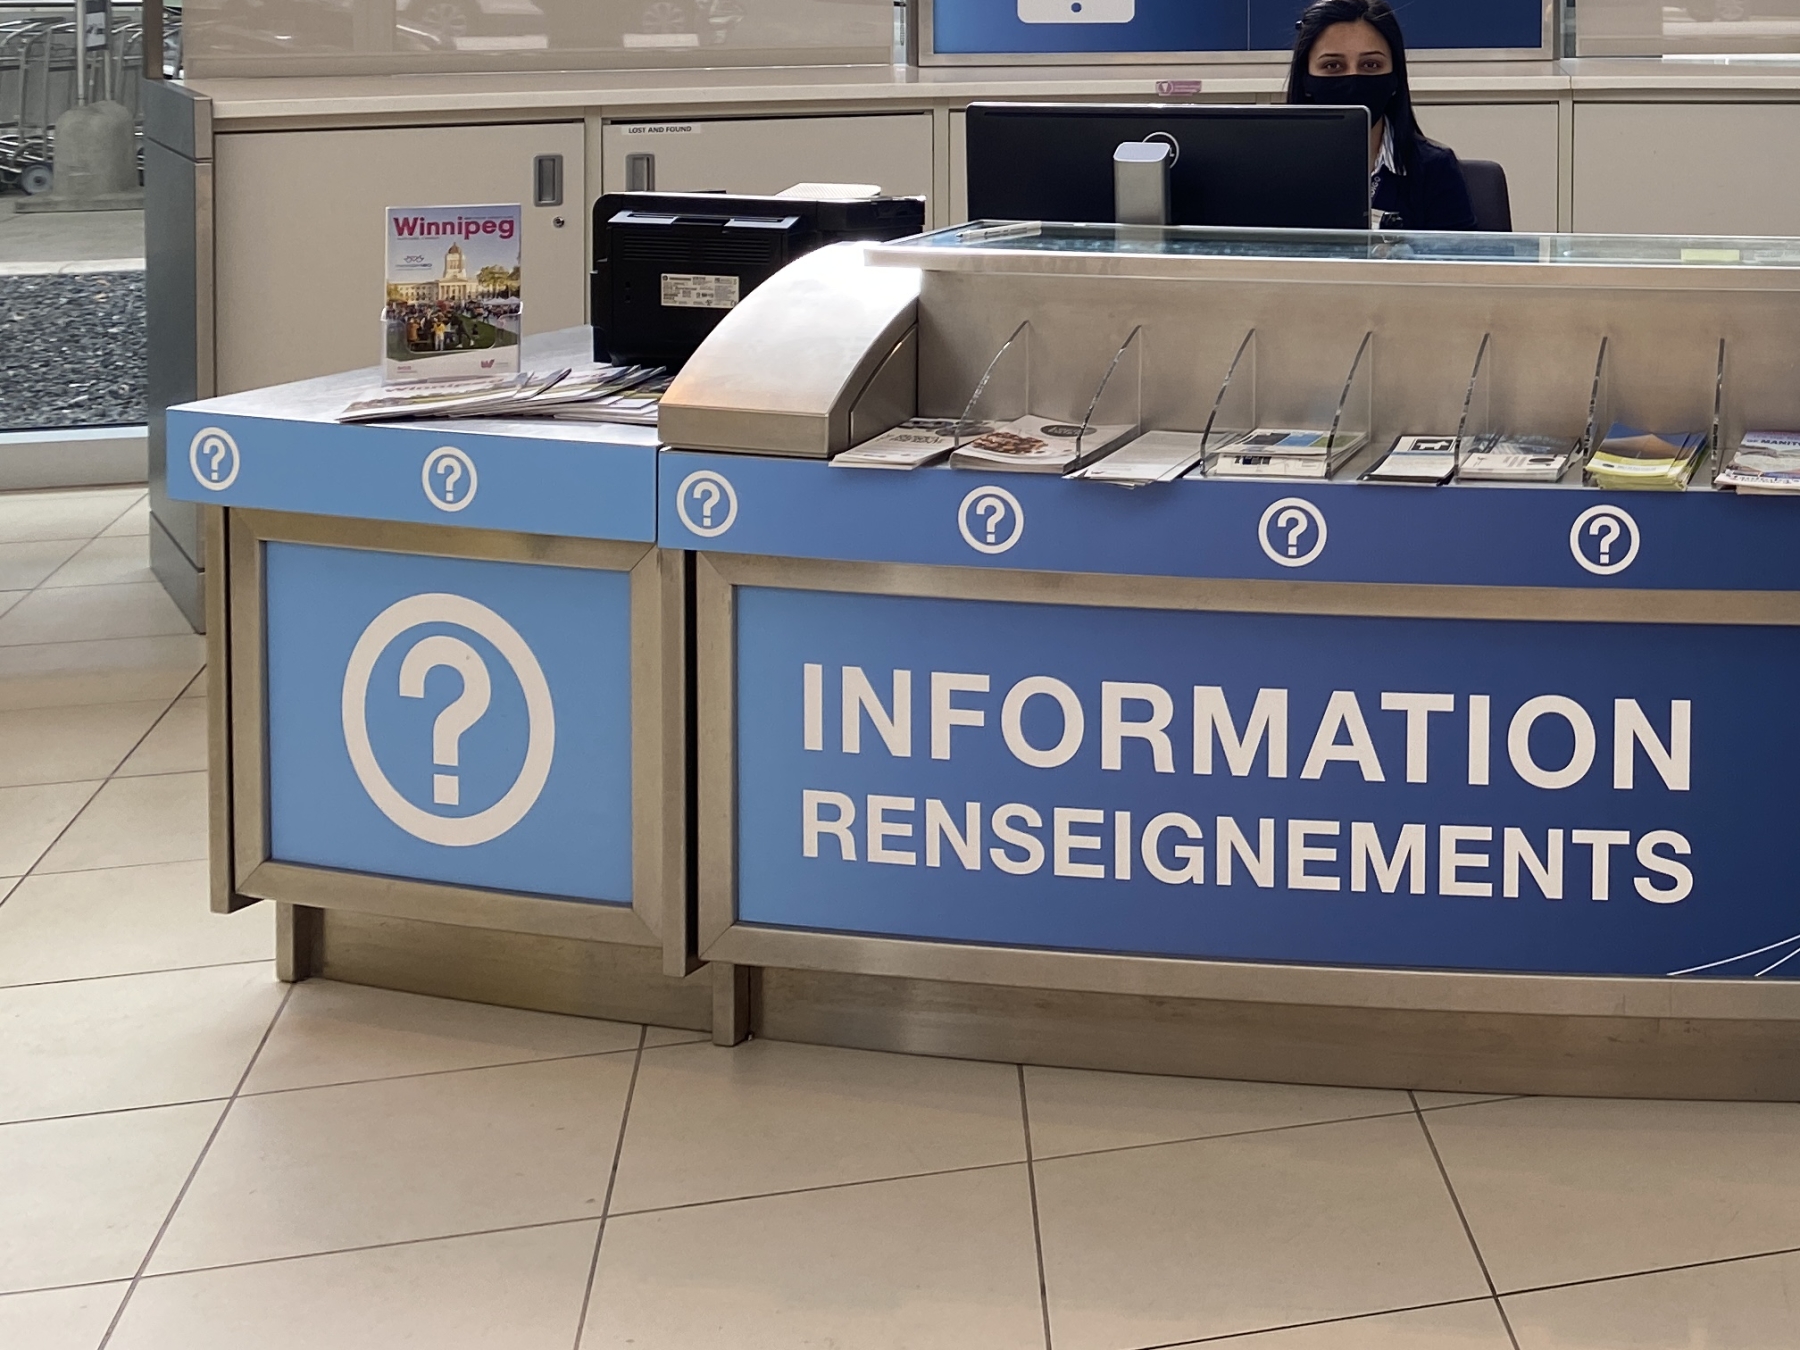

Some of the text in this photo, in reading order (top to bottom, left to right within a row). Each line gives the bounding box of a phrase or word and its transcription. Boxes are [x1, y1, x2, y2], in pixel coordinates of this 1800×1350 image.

[628, 126, 646, 134] LOST
[665, 125, 692, 133] FOUND
[392, 216, 515, 241] Winnipeg
[802, 662, 1693, 792] INFORMATION
[802, 788, 1695, 906] RENSEIGNEMENTS
